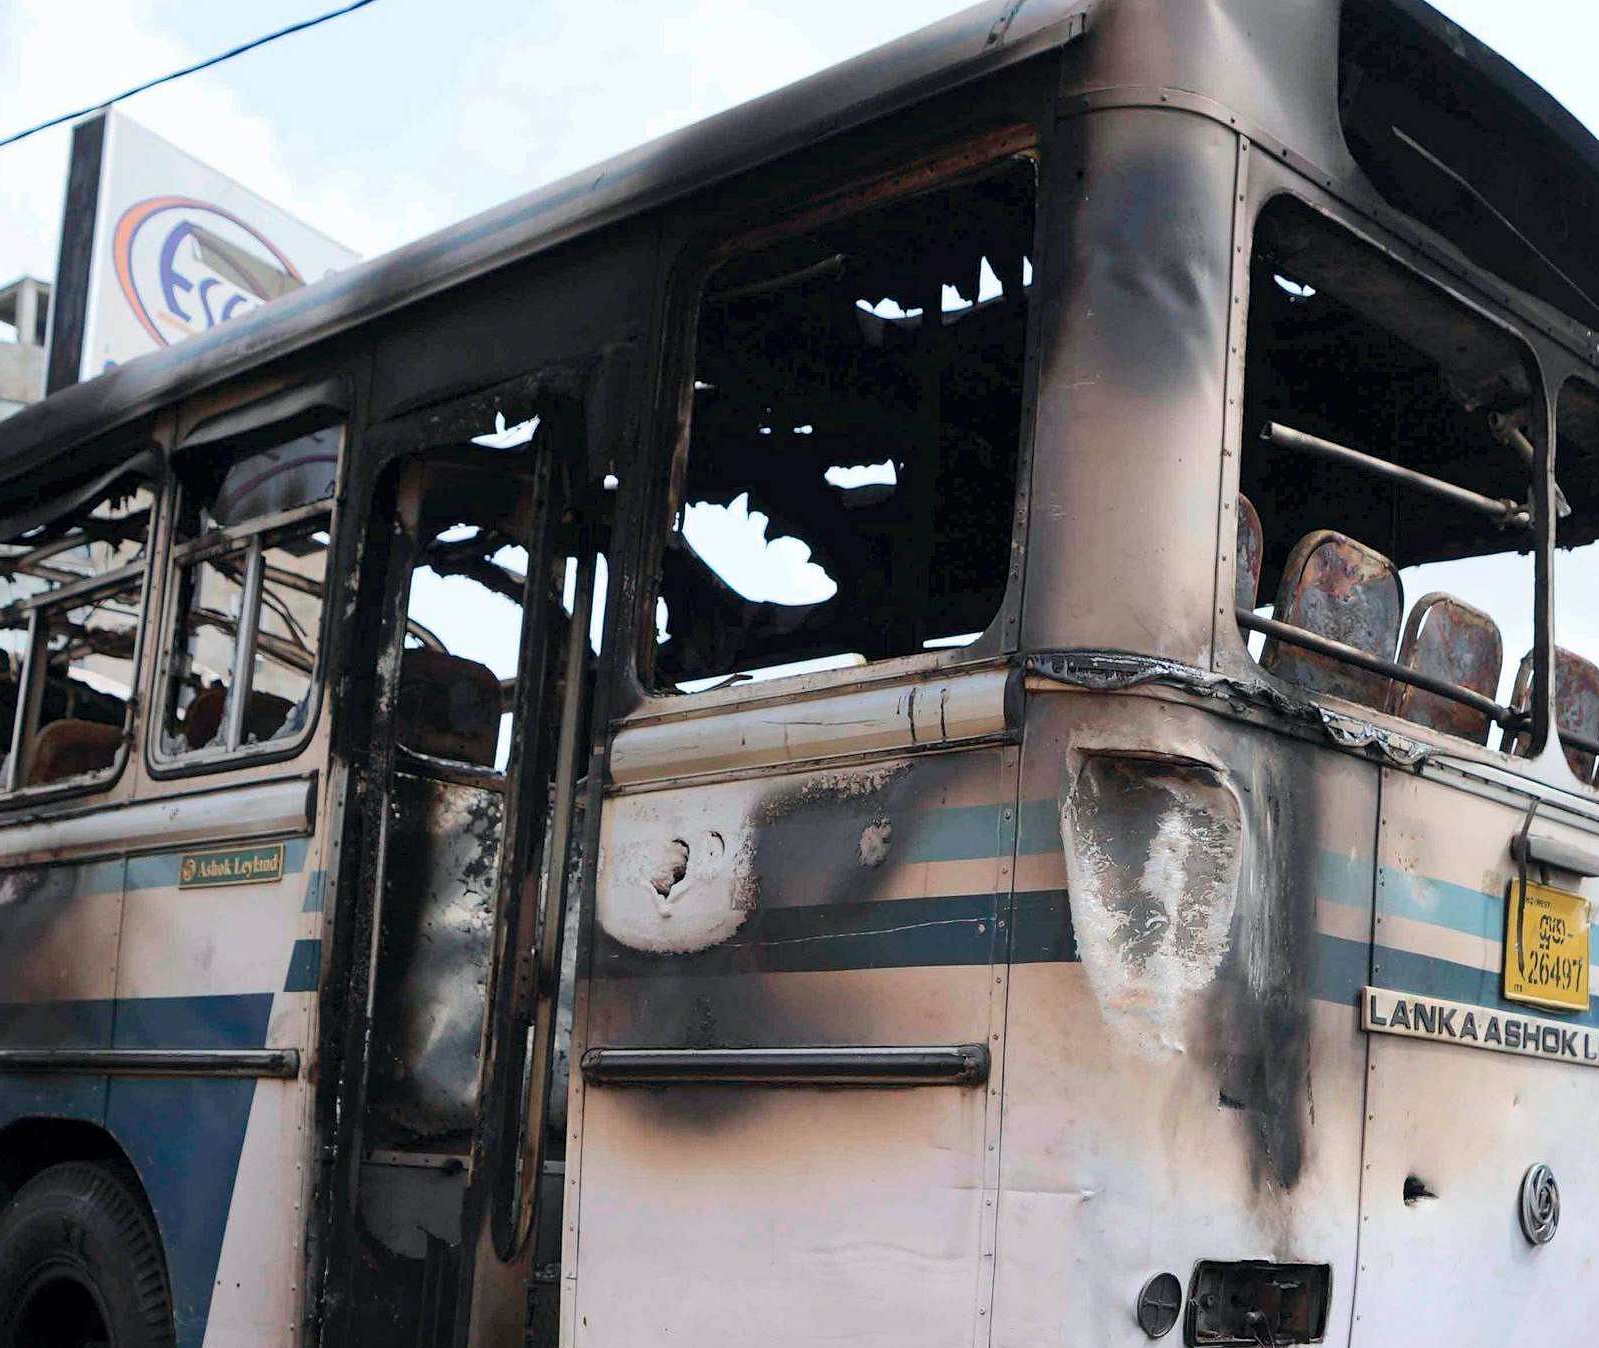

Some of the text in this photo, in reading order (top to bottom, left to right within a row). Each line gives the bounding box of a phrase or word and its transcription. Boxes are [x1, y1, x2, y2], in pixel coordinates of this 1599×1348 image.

[200, 853, 279, 878] Ashok Leyland
[1528, 950, 1583, 993] 26497
[1370, 993, 1480, 1040] LANKA
[1484, 1017, 1579, 1057] ASHOK
